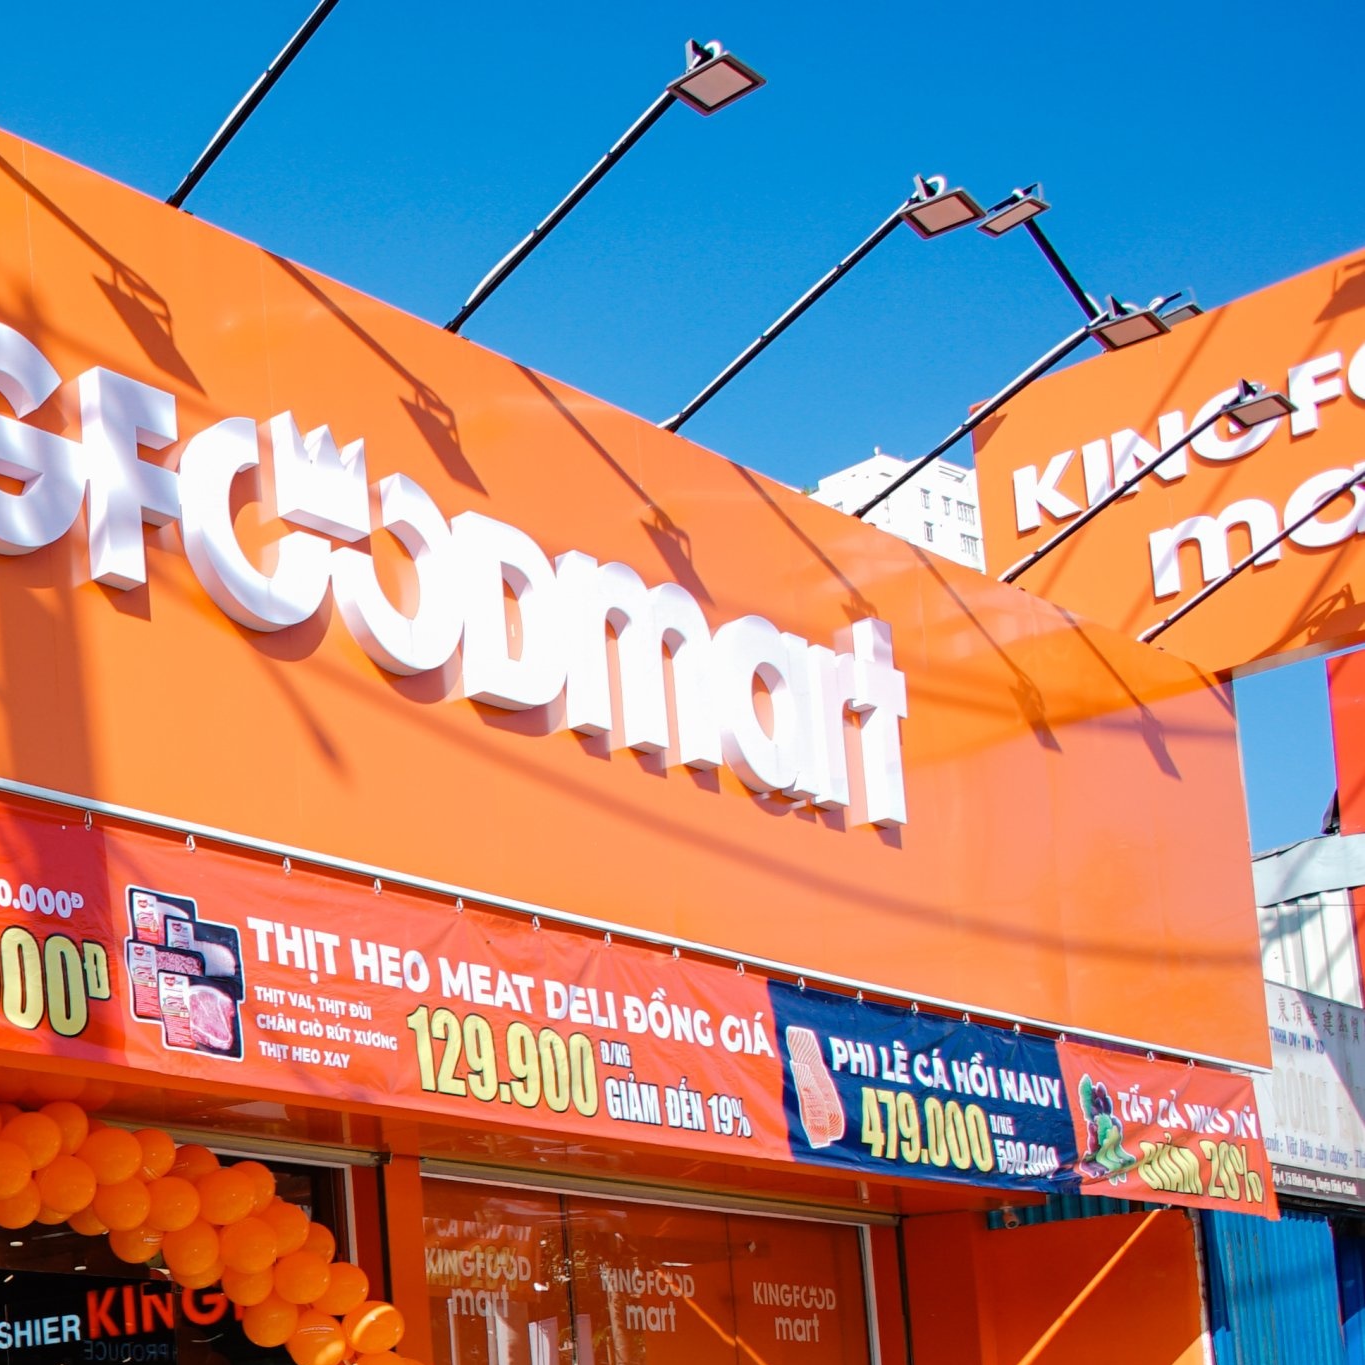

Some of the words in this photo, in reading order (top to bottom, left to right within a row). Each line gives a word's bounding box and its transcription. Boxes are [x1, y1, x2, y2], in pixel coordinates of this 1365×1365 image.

[1013, 341, 1365, 534] KINGF
[246, 916, 341, 985] THỊT
[350, 938, 430, 994] HEO
[438, 956, 534, 1015] MEAT
[543, 979, 619, 1030] DELI
[623, 987, 715, 1048] ĐỒNG
[719, 1010, 776, 1058] GIÁ
[253, 985, 287, 1009] THỊT
[287, 991, 316, 1013] VAI,
[317, 996, 348, 1019] THỊT
[348, 1001, 373, 1021] ĐÙI
[256, 1012, 297, 1034] CHÂN
[300, 1018, 324, 1038] GIÒ
[326, 1022, 351, 1043] RÚT
[353, 1028, 399, 1051] XƯƠNG
[258, 1040, 289, 1063] THỊT
[292, 1047, 321, 1065] HEO
[323, 1051, 351, 1069] XAY
[406, 1003, 599, 1118] 129.900
[604, 1072, 663, 1126] GIẢM
[664, 1077, 707, 1132] ĐẾN
[707, 1095, 753, 1139] 19%
[828, 1036, 876, 1078] PHI
[878, 1040, 911, 1084] LÊ
[913, 1048, 952, 1091] CÁ
[951, 1051, 998, 1098] HỒI
[999, 1068, 1063, 1110] NAUY
[860, 1086, 995, 1173] 479.000
[1117, 1083, 1153, 1125] TẤT
[1156, 1088, 1188, 1130] CẢ
[1183, 1102, 1231, 1135] NHO
[1226, 1104, 1260, 1140] MỸ
[1137, 1131, 1204, 1196] GIẢM
[1198, 1138, 1265, 1203] 20%
[86, 1282, 247, 1341] KING
[774, 1312, 820, 1343] mart
